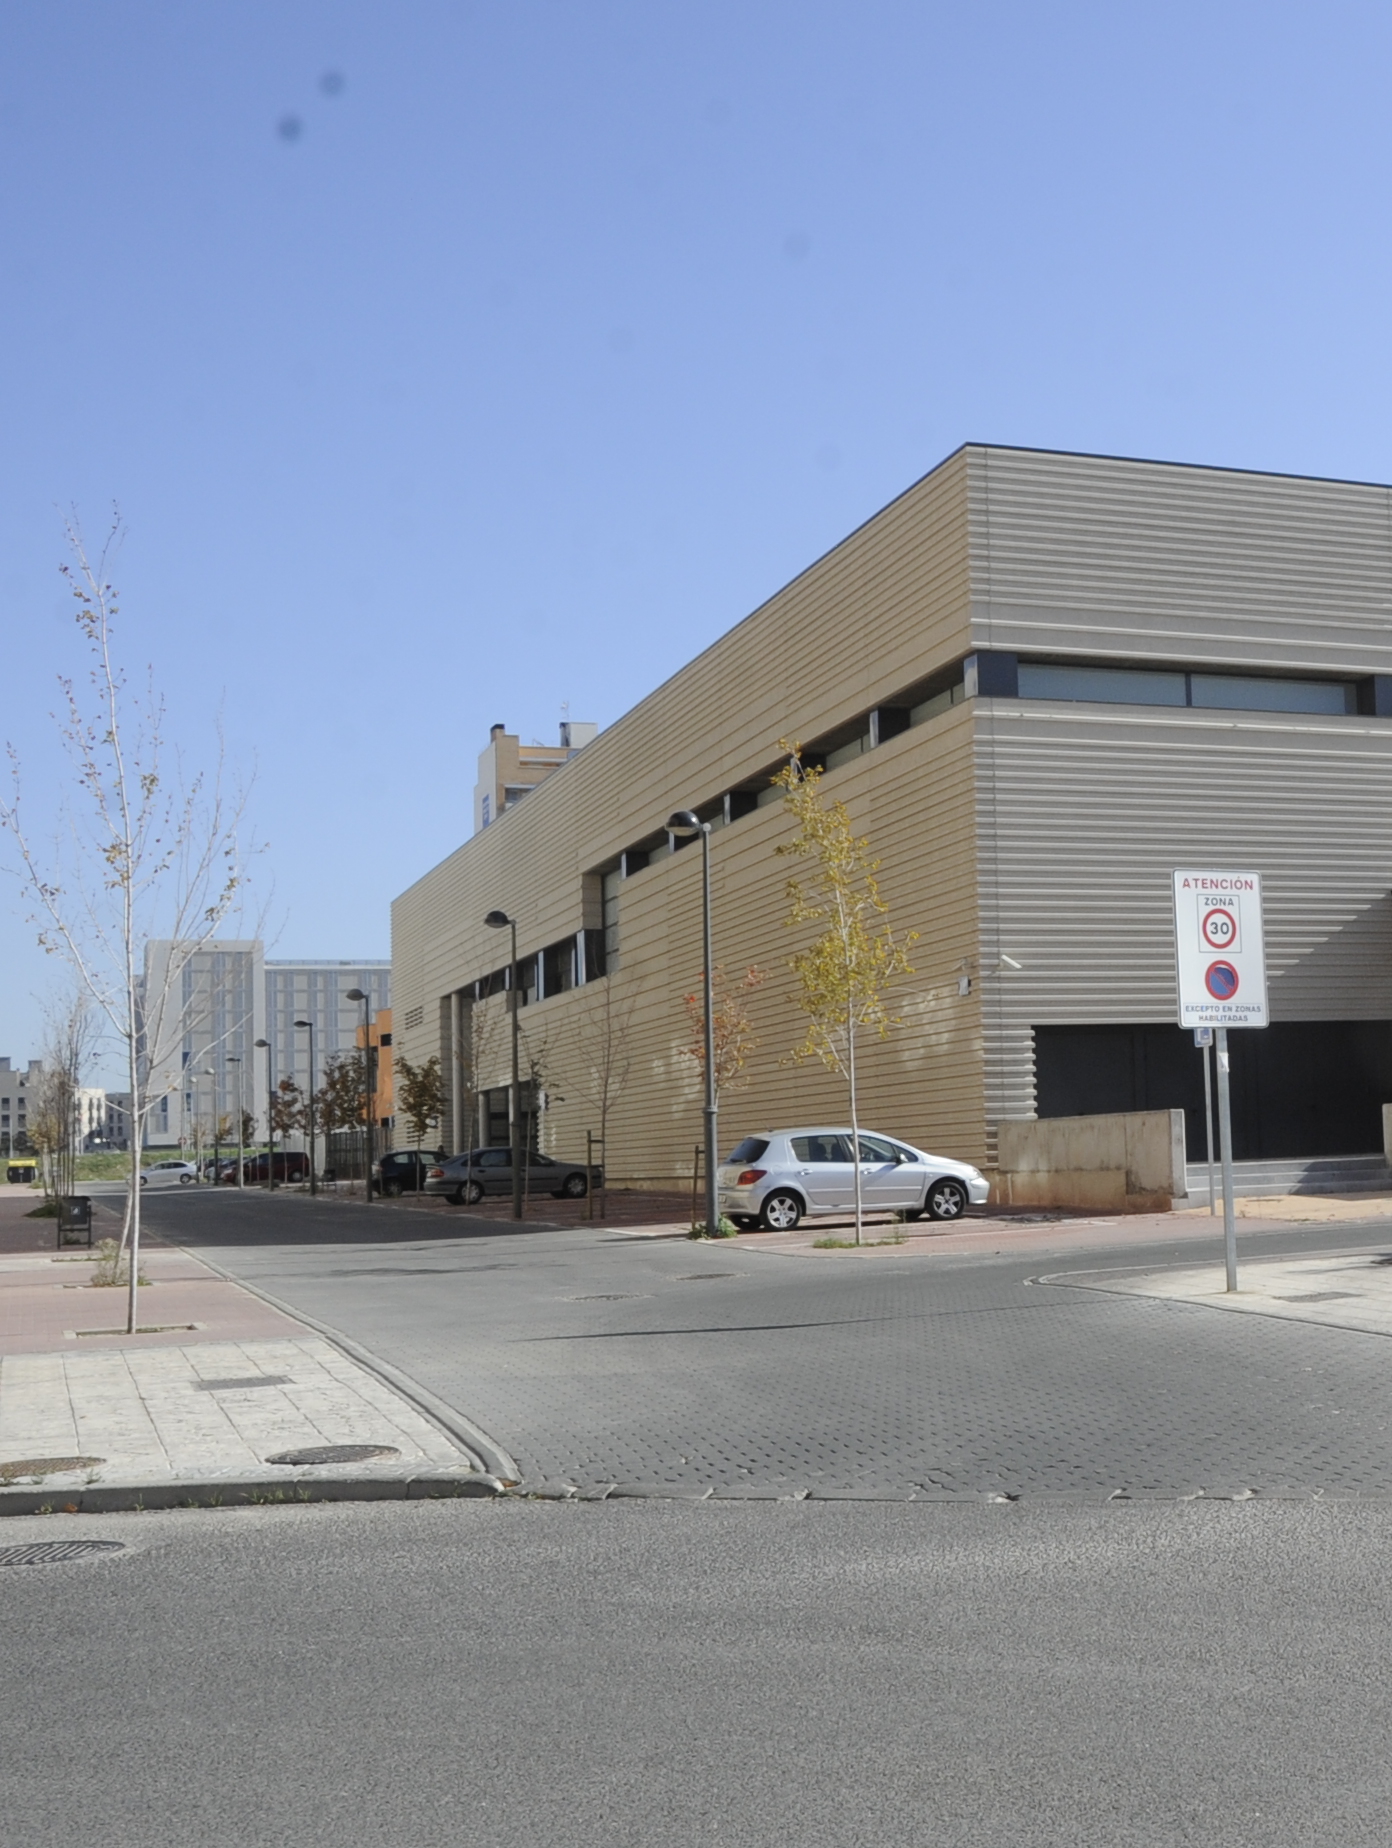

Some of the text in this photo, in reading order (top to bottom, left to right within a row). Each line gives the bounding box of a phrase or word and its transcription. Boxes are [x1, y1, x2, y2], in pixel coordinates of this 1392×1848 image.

[1182, 876, 1254, 891] ATENCIÓN
[1204, 897, 1235, 907] ZONA
[1210, 922, 1230, 935] 30
[1185, 1005, 1262, 1013] EXCEPTO EN ZONAS
